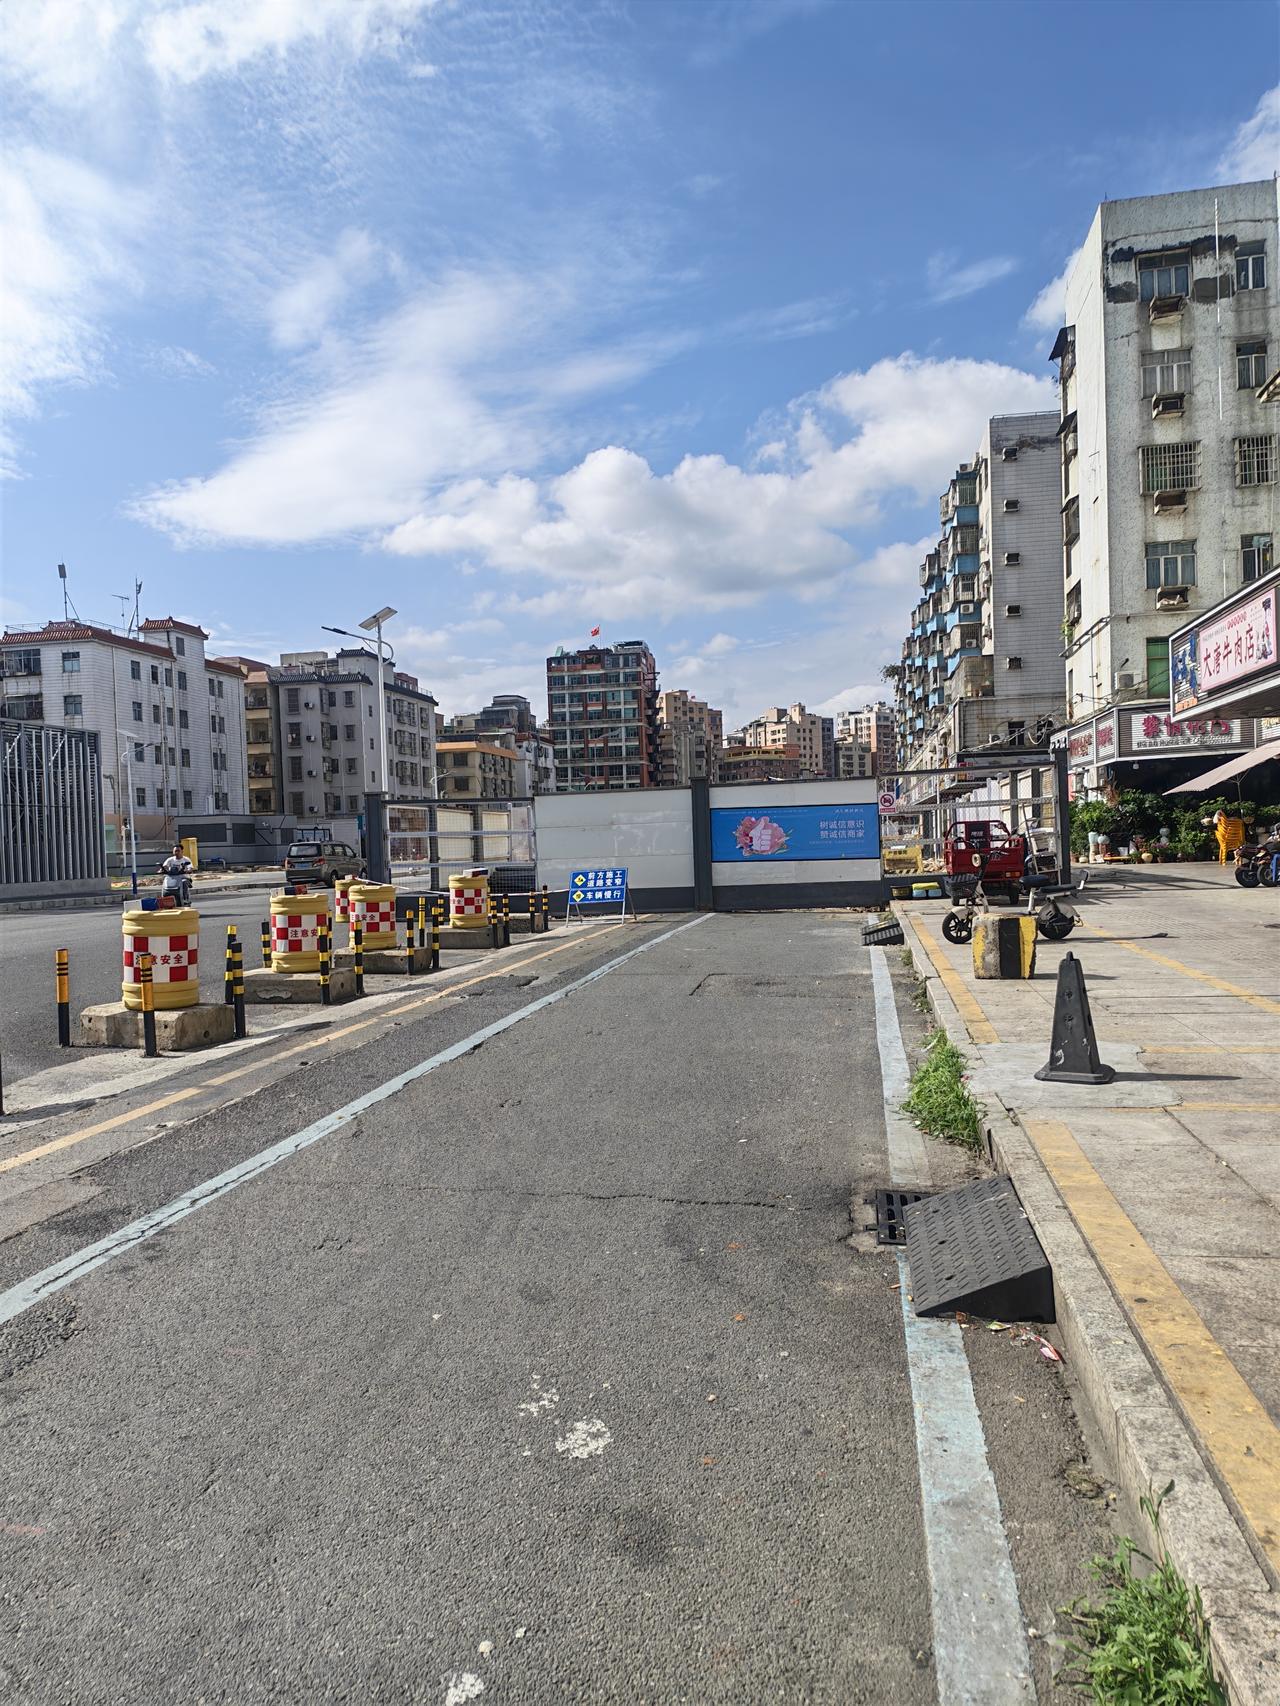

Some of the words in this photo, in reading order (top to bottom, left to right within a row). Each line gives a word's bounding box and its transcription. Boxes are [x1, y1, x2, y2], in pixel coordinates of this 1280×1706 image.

[1203, 622, 1255, 679] 大唐牛肉店
[587, 870, 623, 880] 前方施工
[586, 878, 622, 888] 道路变窄
[585, 890, 621, 900] 车辆慢行
